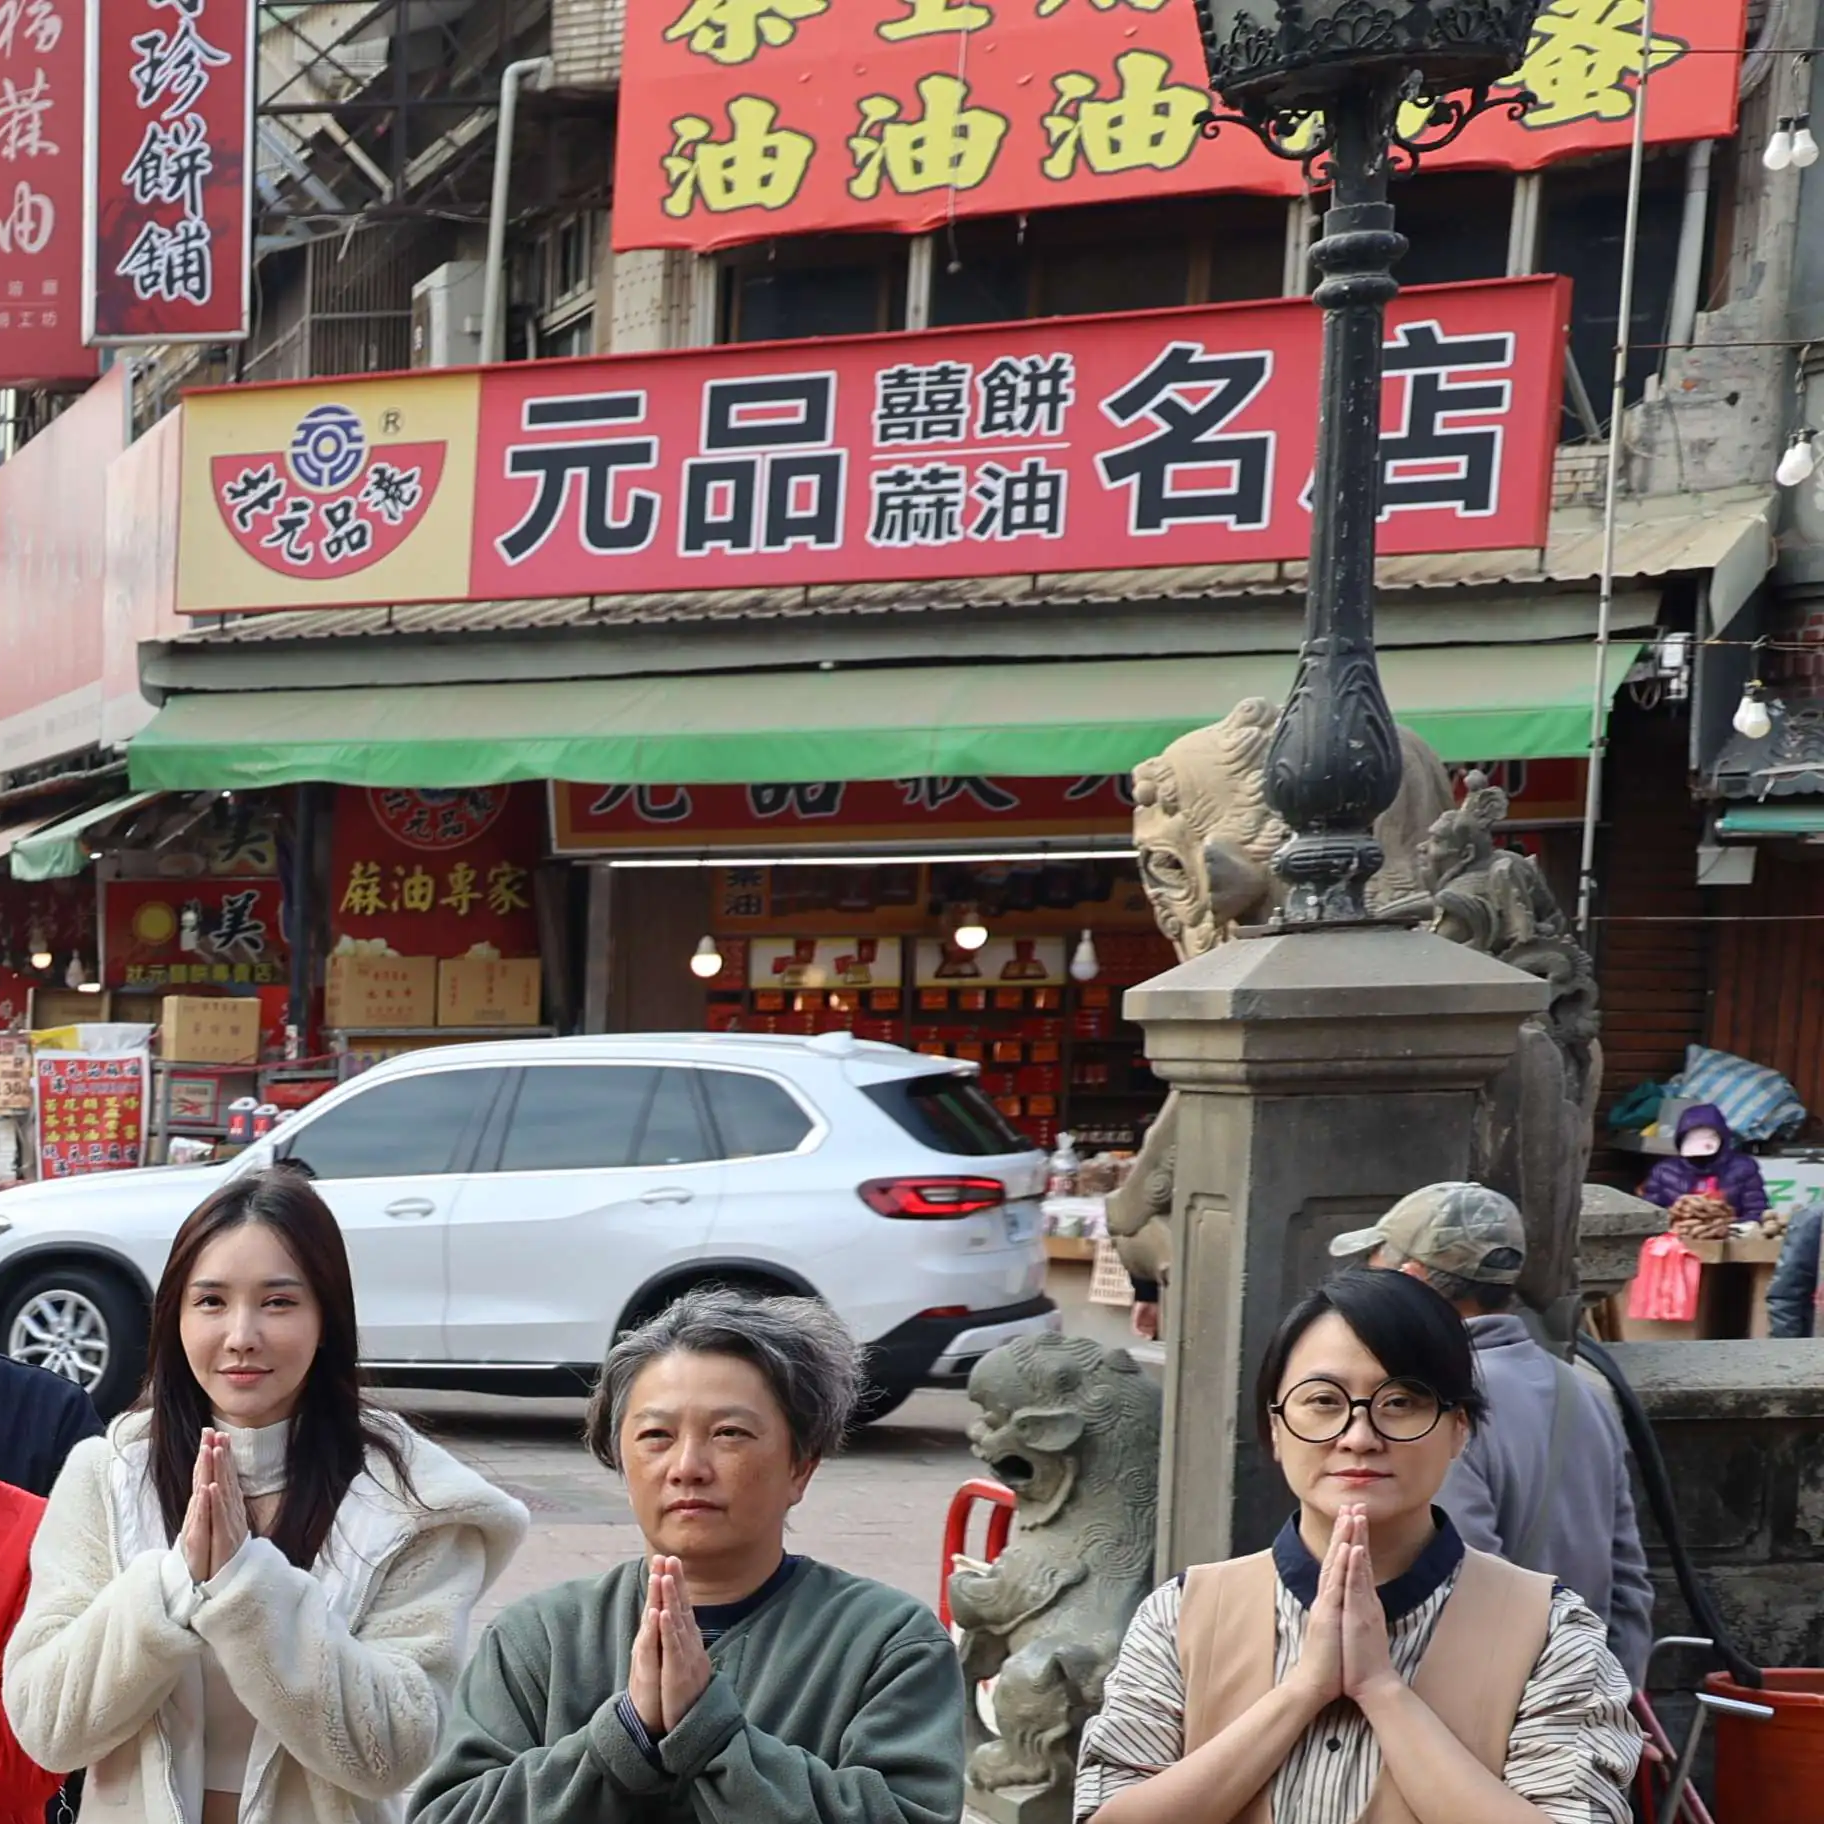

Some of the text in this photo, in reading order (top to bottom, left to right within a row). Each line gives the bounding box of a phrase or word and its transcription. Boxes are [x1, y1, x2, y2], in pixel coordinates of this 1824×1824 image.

[495, 366, 849, 564] 元品
[871, 350, 1074, 449] 囍餅
[1096, 321, 1516, 535] 名店
